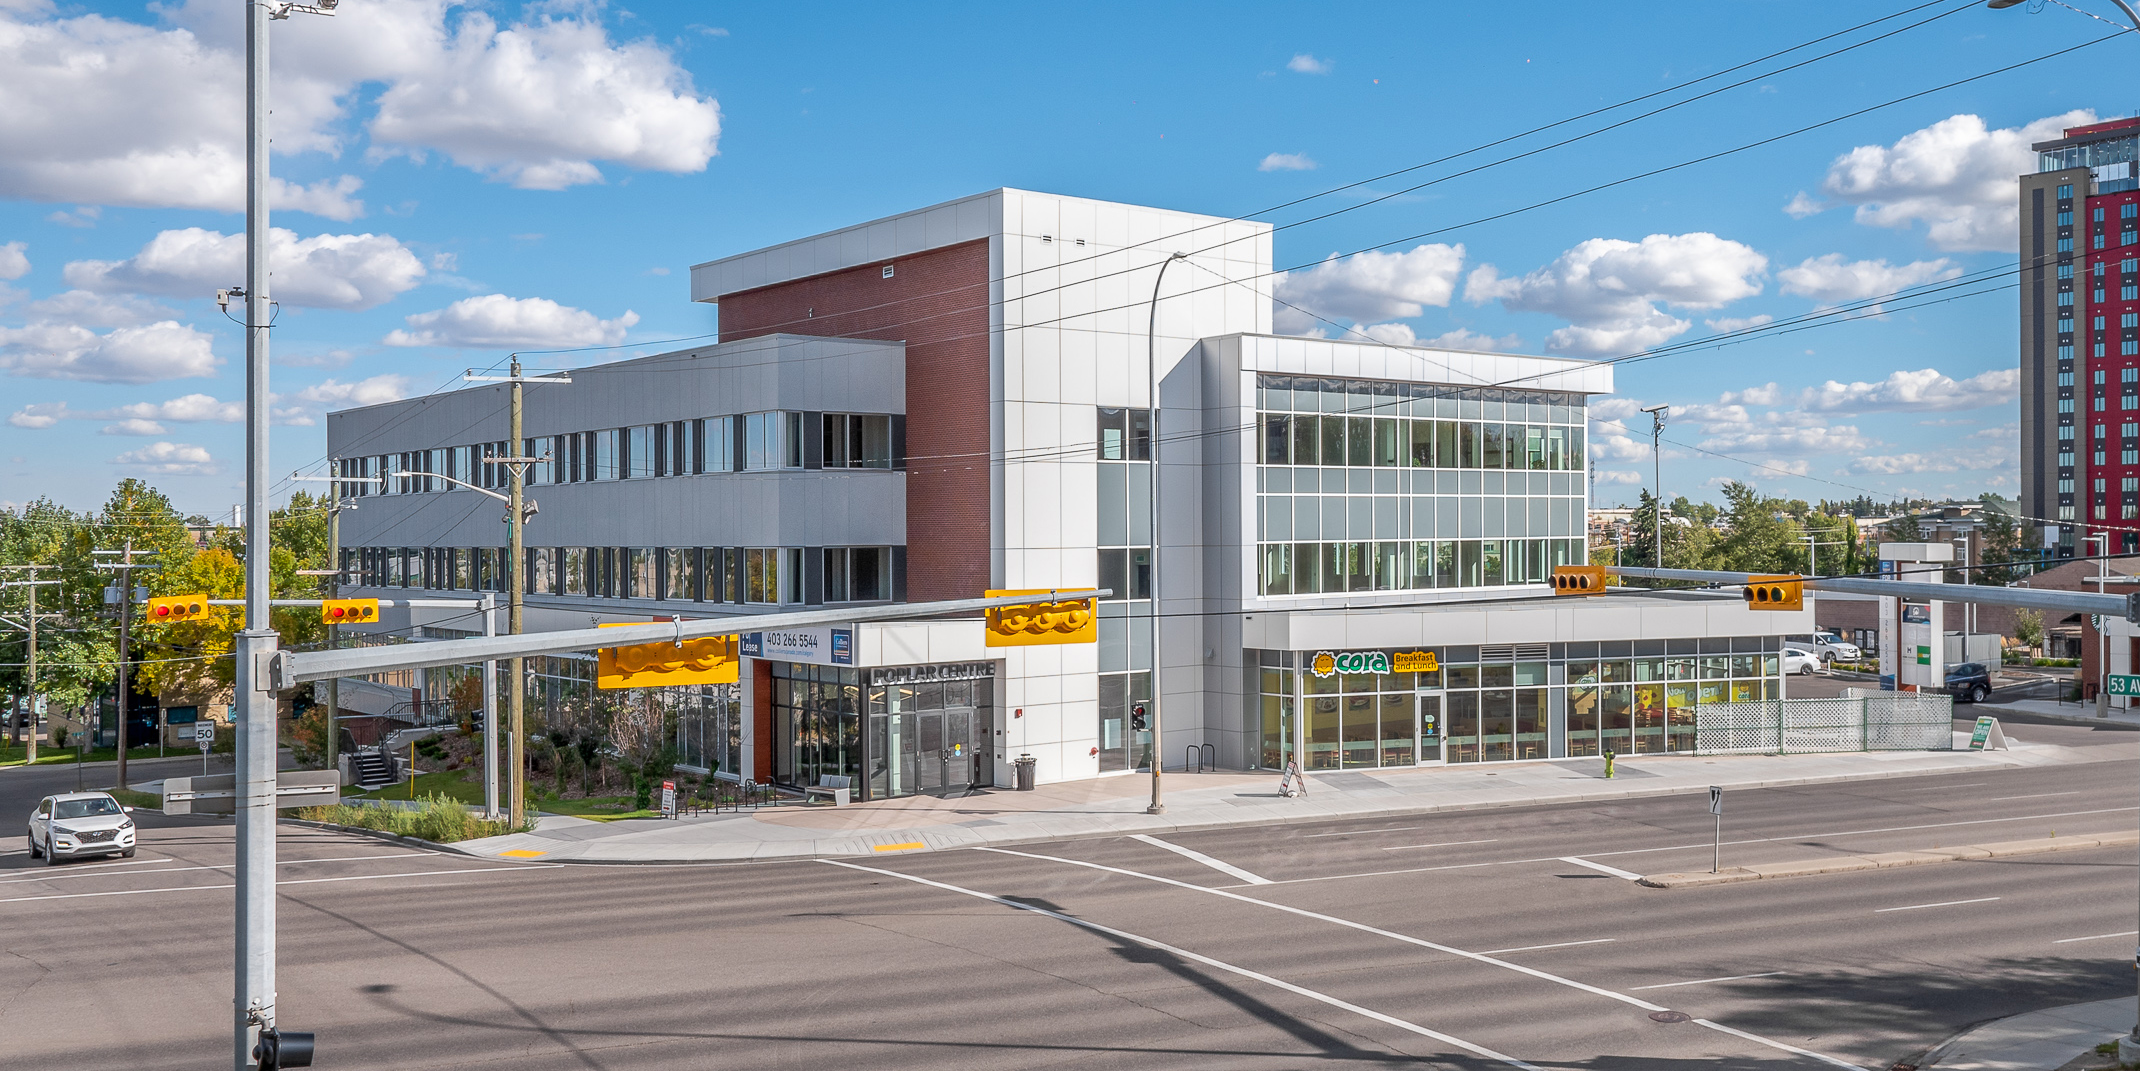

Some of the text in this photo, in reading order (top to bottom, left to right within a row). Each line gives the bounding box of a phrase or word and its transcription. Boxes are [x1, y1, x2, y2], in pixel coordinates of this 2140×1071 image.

[742, 641, 758, 652] Lease
[766, 632, 818, 648] 403 266 5544
[1336, 652, 1388, 672] cora
[1395, 653, 1434, 662] Breakfast
[873, 662, 995, 682] POPLAR CENTRE
[1395, 662, 1437, 670] and Lunch
[2111, 677, 2125, 692] 53
[197, 729, 212, 739] 50
